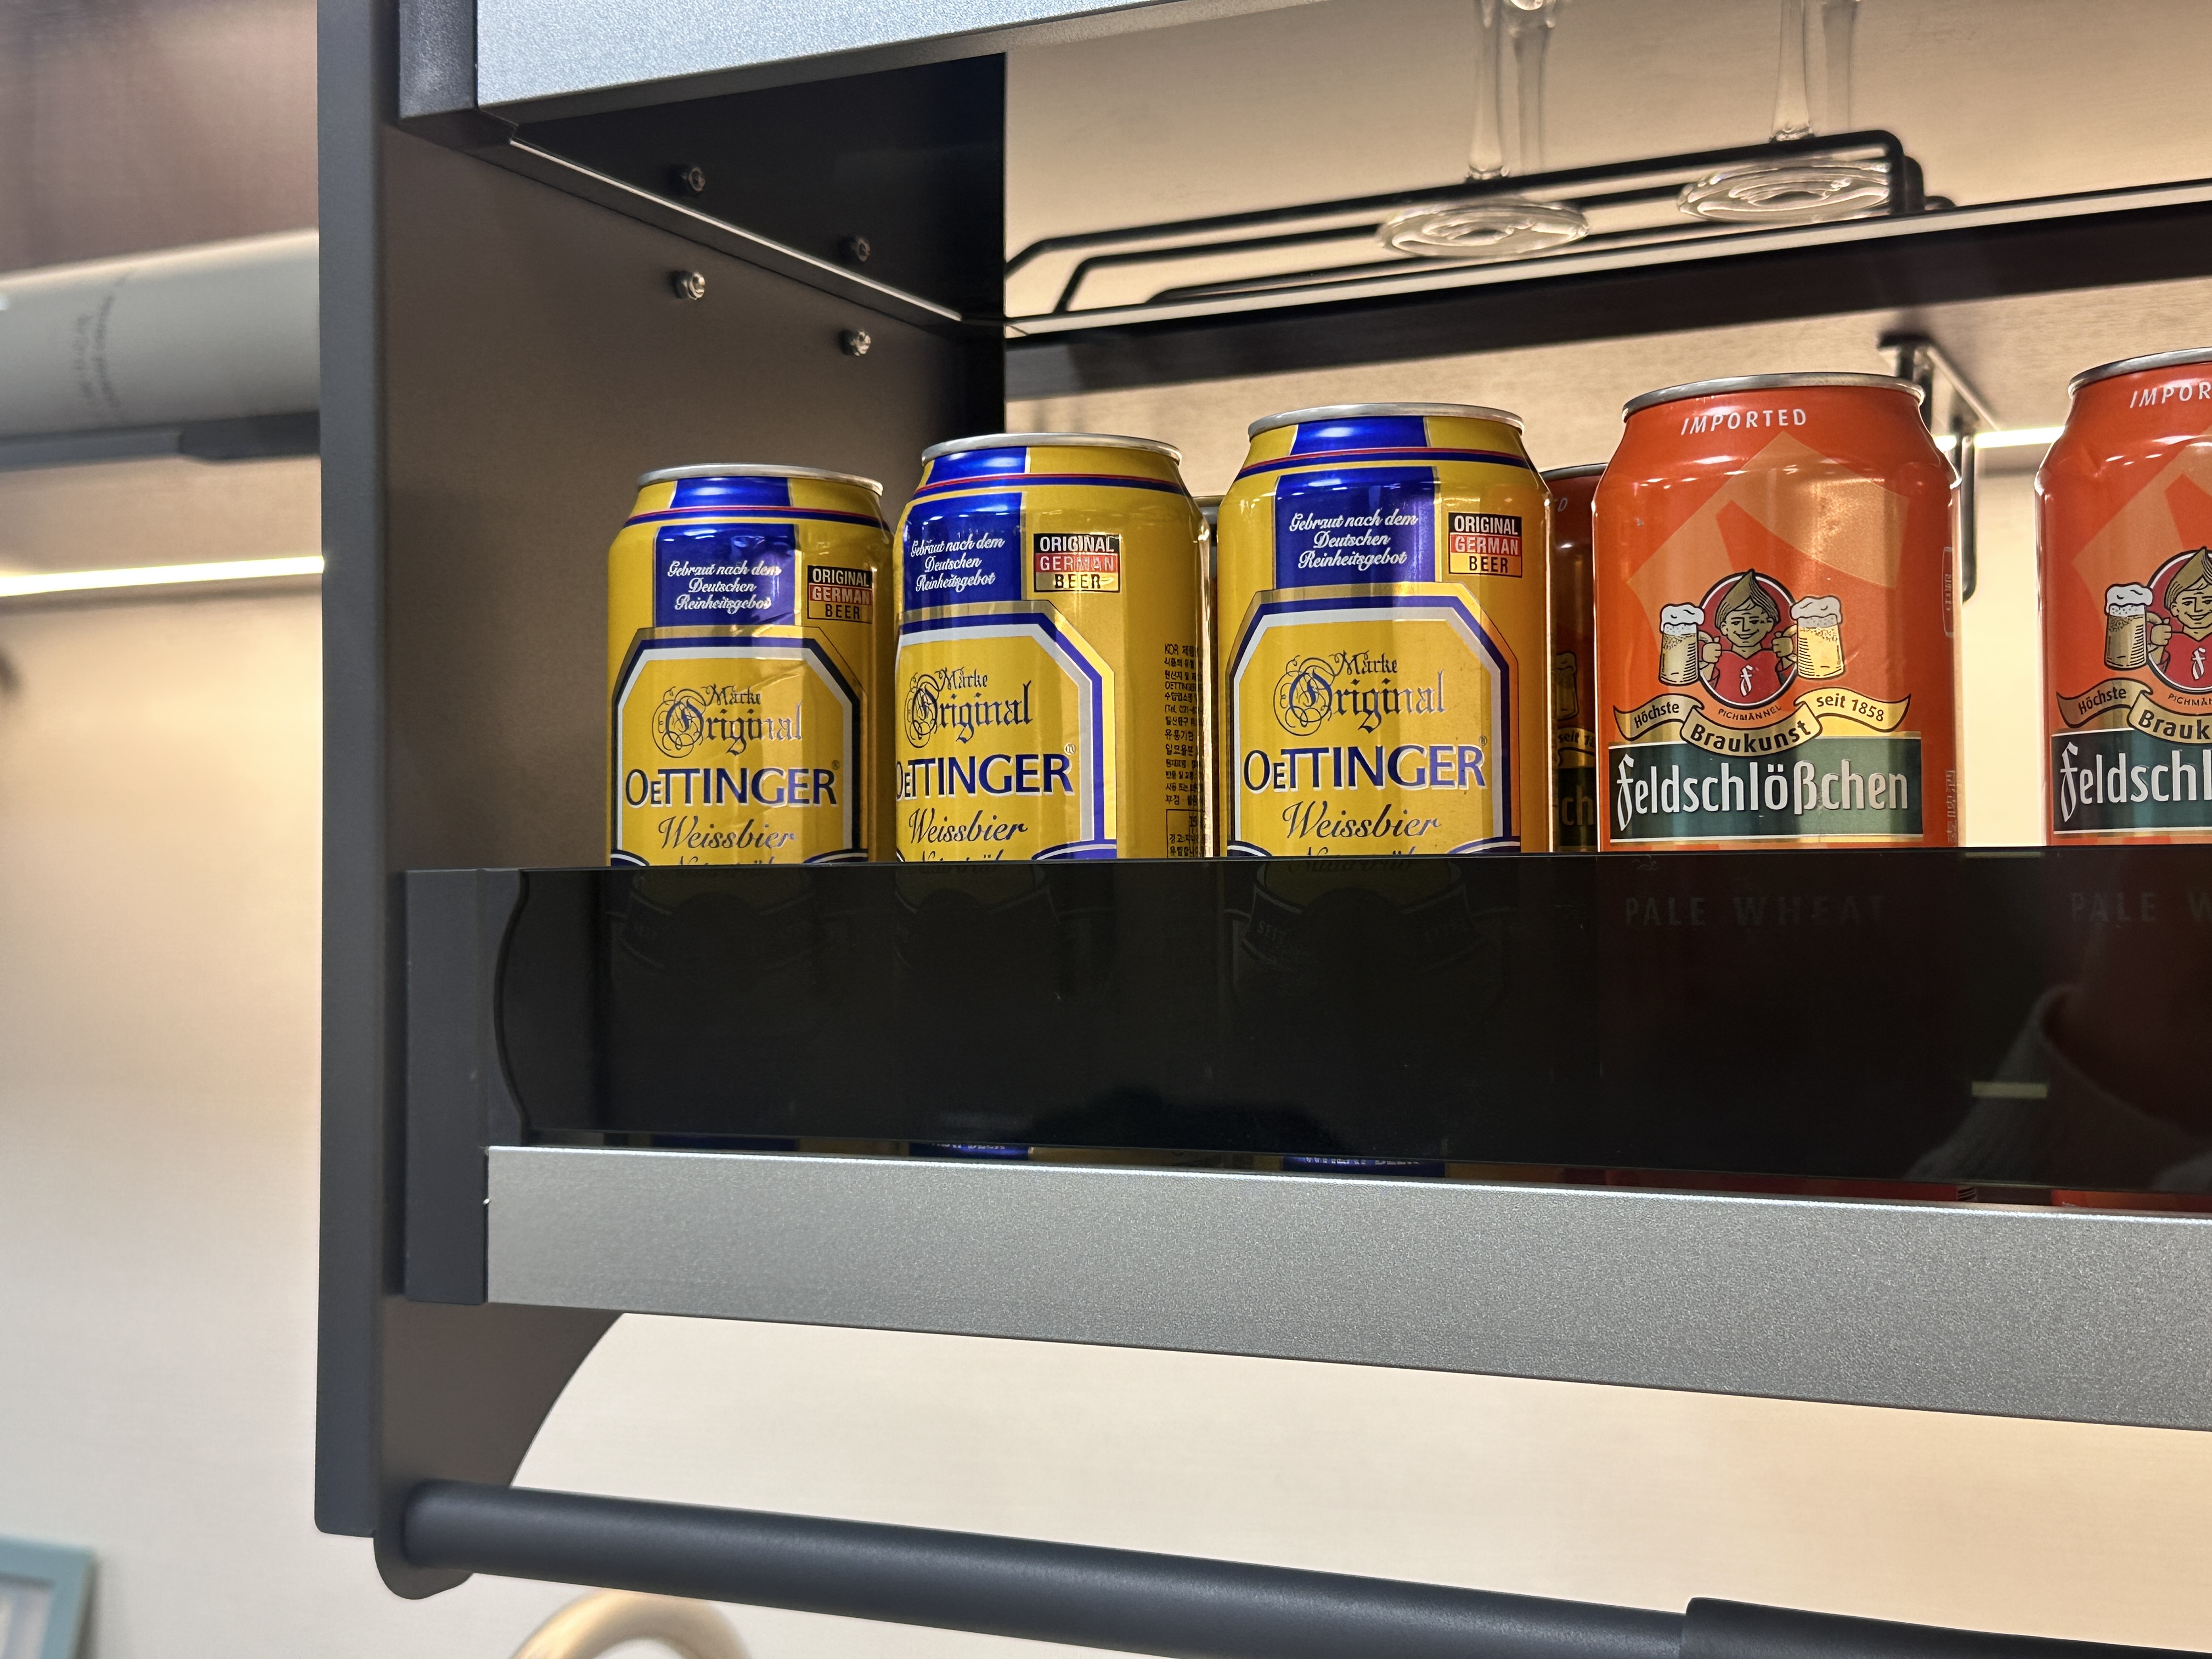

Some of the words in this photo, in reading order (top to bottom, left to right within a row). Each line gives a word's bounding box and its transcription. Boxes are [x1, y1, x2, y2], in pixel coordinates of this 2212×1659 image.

[2129, 381, 2211, 408] IMPOR
[1681, 409, 1807, 436] IMPORTED
[1289, 512, 1344, 532] Gebraut
[1345, 508, 1383, 527] nach
[1384, 509, 1419, 526] dem
[1454, 515, 1518, 535] ORIGINAL
[946, 533, 975, 552] nach
[976, 532, 1005, 549] dem
[1040, 535, 1114, 553] ORIGINAL
[1313, 529, 1391, 549] Deutschen
[1454, 534, 1518, 555] GERMAN
[667, 561, 715, 577] Gebraut
[716, 560, 749, 575] nach
[751, 560, 782, 575] dem
[924, 552, 982, 573] Deutschen
[1040, 555, 1114, 572] GERMAN
[1298, 548, 1407, 571] Reinheitsgebot
[1469, 556, 1509, 573] BEER
[688, 577, 757, 593] Deutschen
[812, 568, 870, 588] ORIGINAL
[916, 569, 996, 592] Reinheitsgebot
[1054, 574, 1102, 589] BEER
[674, 594, 772, 614] Reinheitsgebot
[812, 585, 872, 605] GERMAN
[825, 605, 860, 620] BEER
[1273, 657, 1446, 736] Original
[1817, 692, 1846, 708] seit
[1851, 698, 1885, 723] 1858
[2079, 686, 2127, 716] Höchste
[904, 673, 1033, 748] Original
[1634, 701, 1680, 729] Höchste
[652, 688, 803, 758] Original
[2138, 709, 2211, 740] Brauk
[1690, 719, 1812, 753] Braukunst
[2060, 742, 2212, 823] feldschl
[909, 808, 1028, 844] Weissbier
[1282, 800, 1442, 839] Weissbier
[658, 815, 797, 850] Weissbier
[1624, 896, 1706, 926] PALE
[1732, 894, 1884, 926] WHEAT
[2070, 892, 2155, 922] PALE
